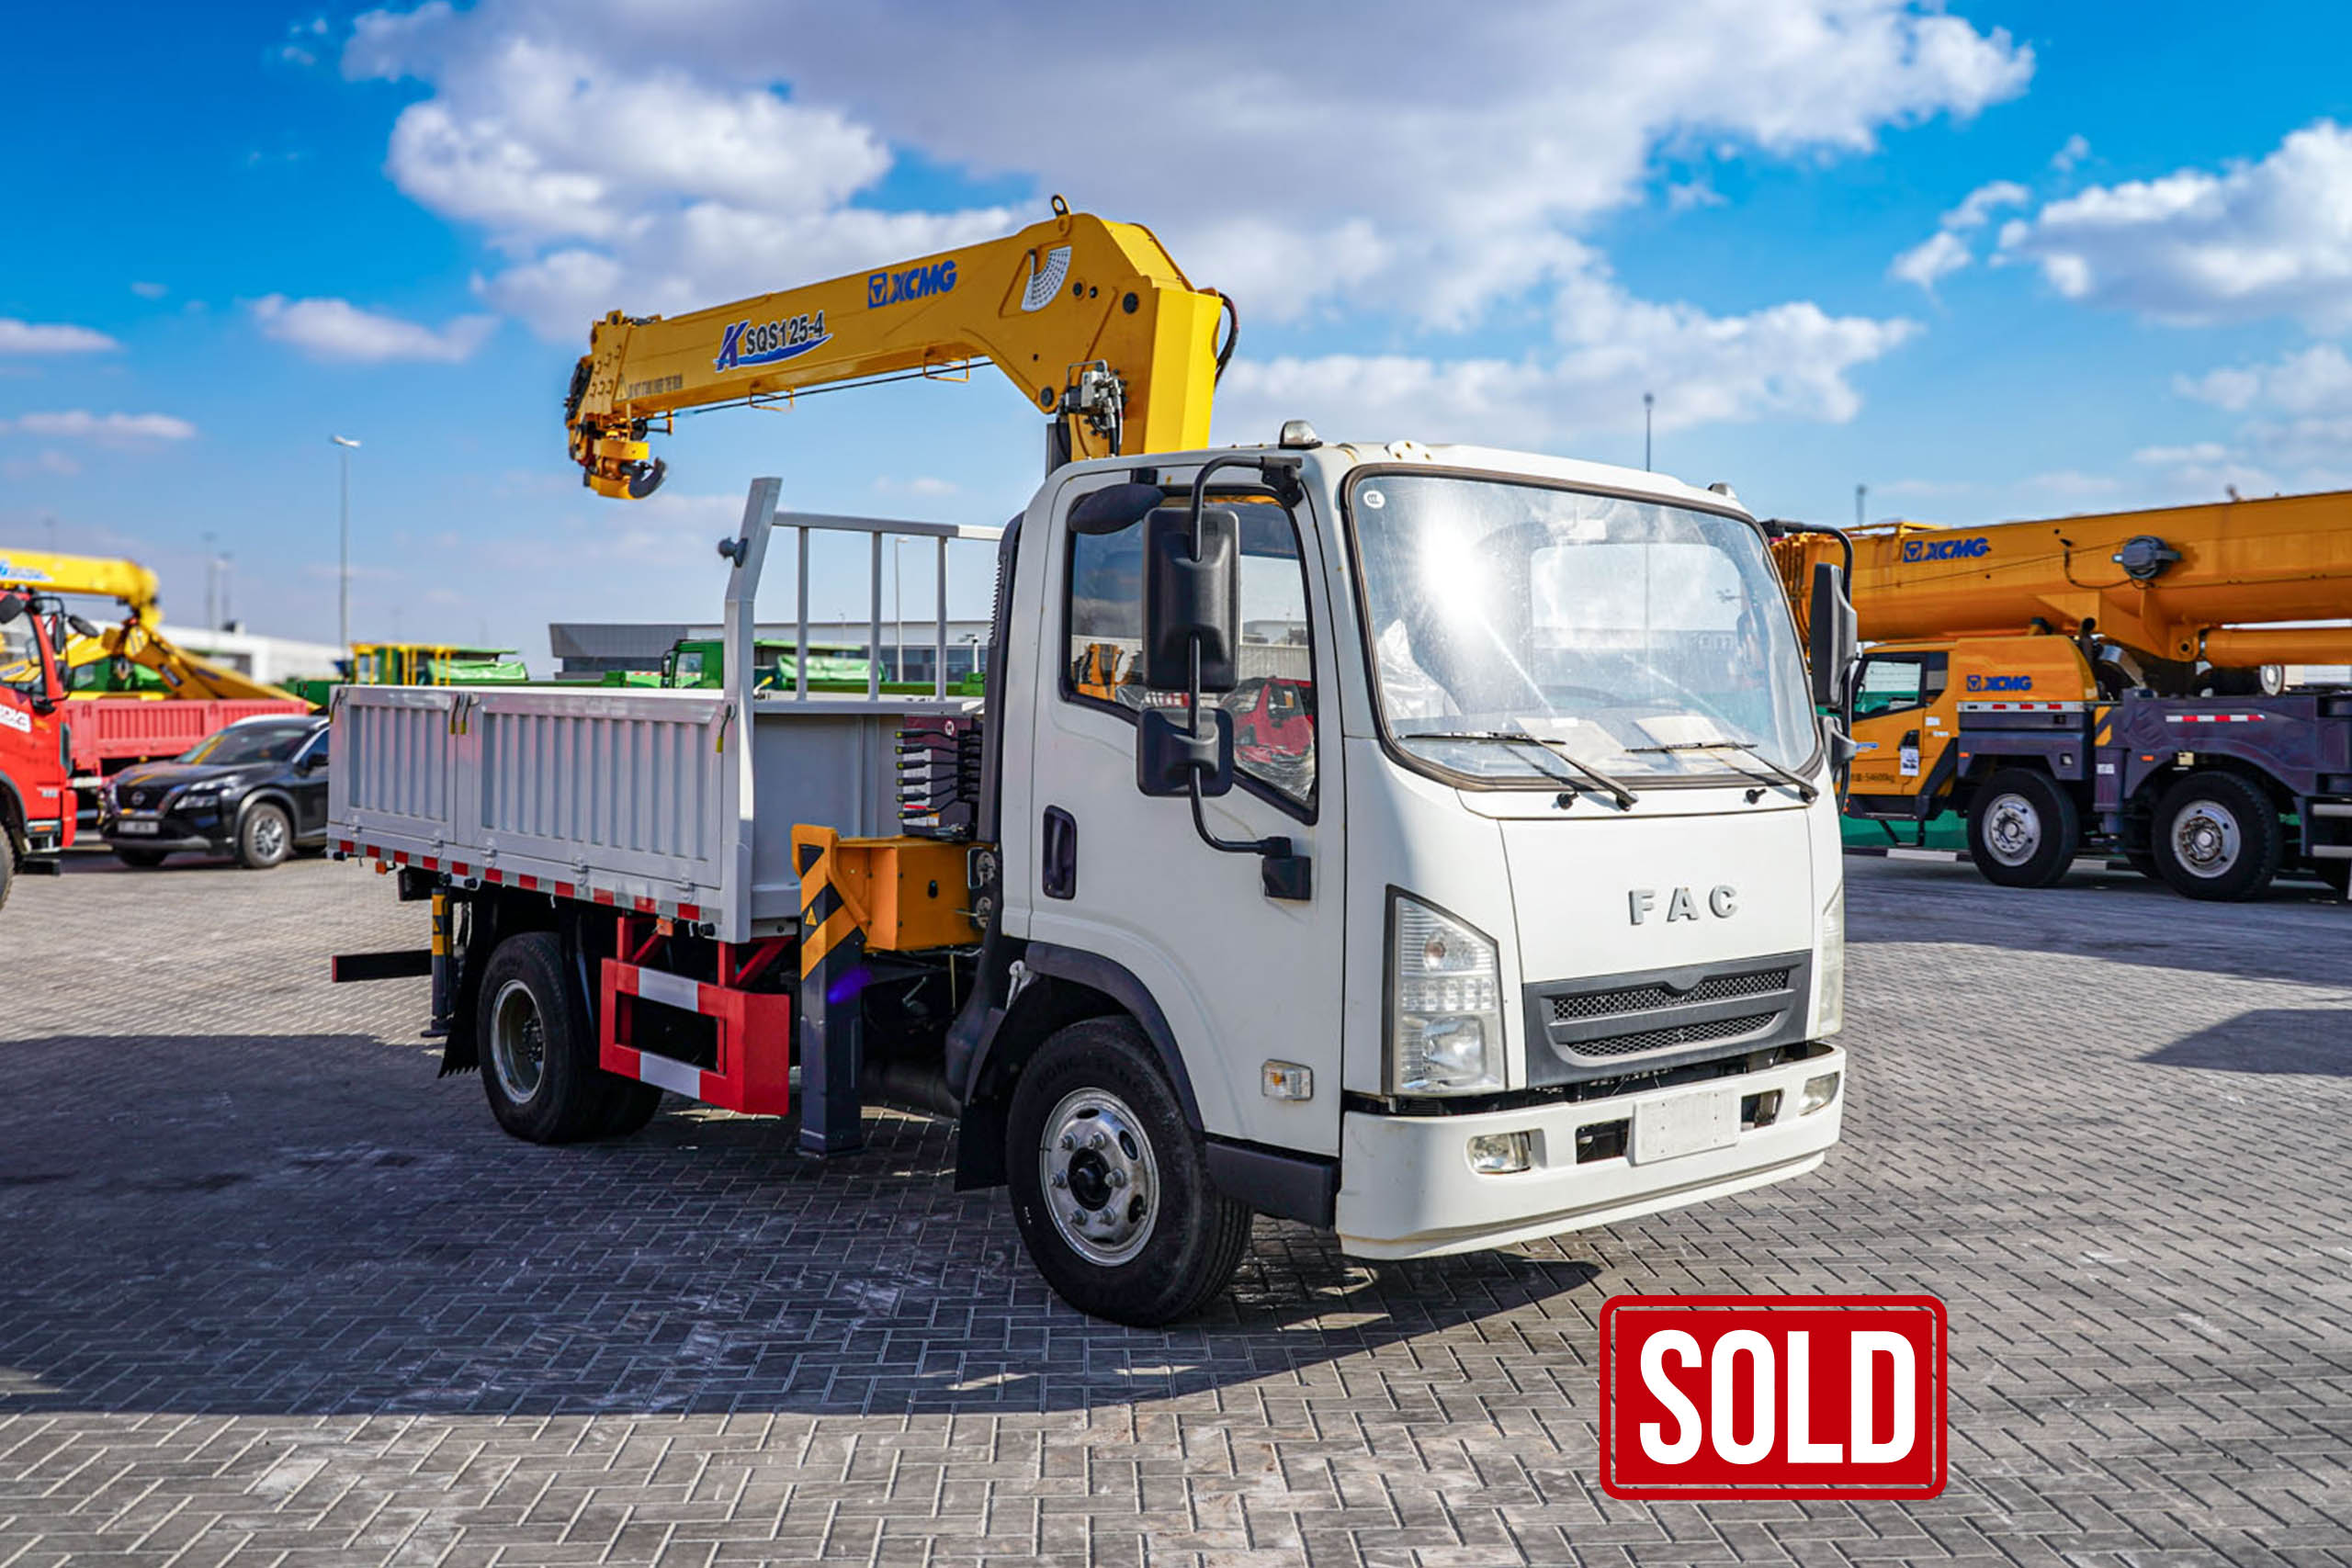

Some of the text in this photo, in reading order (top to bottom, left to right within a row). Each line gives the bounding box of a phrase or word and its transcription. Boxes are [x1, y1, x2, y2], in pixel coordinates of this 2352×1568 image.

[889, 260, 957, 305] XCMG
[746, 310, 824, 355] SQS125-4
[1923, 536, 1989, 561] XCMG
[1984, 675, 2032, 691] XCMG
[1628, 885, 1737, 926] FAC
